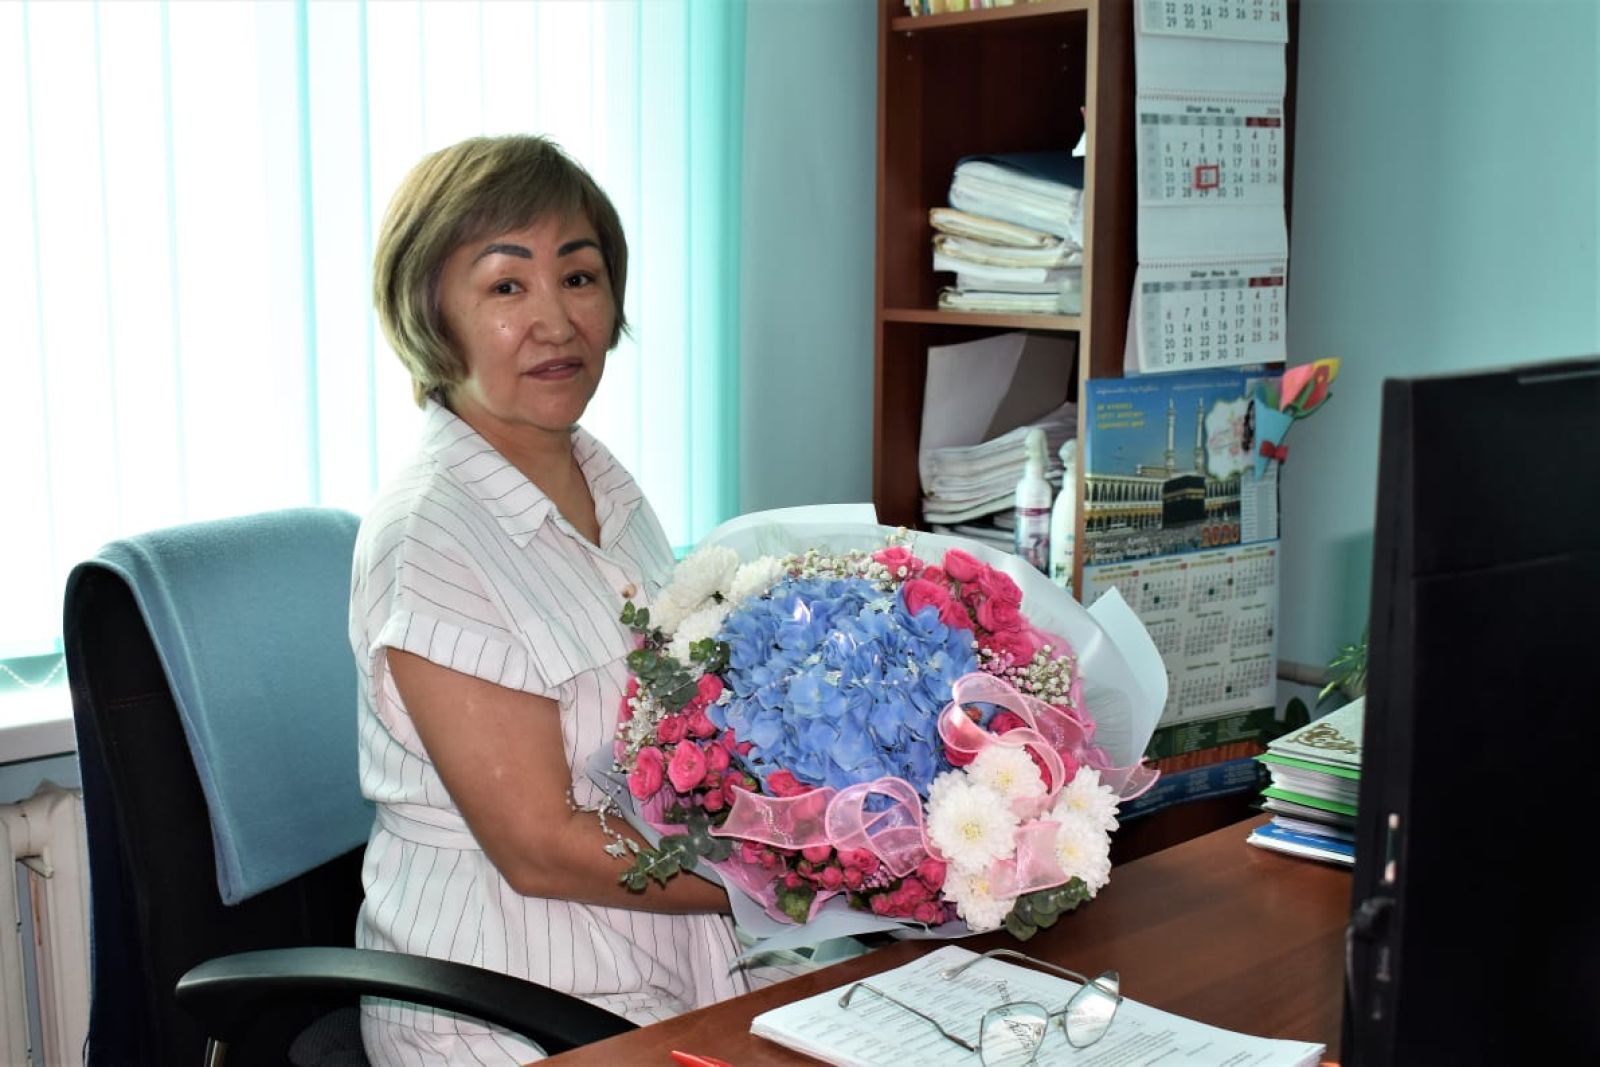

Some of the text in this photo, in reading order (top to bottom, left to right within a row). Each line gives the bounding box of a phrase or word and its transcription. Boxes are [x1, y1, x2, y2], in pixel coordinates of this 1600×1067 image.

[1201, 5, 1211, 16] 24
[1218, 7, 1229, 18] 25
[1253, 10, 1263, 20] 27
[1182, 142, 1187, 151] 7
[1233, 143, 1242, 153] 10
[1181, 158, 1190, 168] 14
[1233, 158, 1241, 168] 17
[1236, 304, 1245, 314] 10
[1270, 302, 1279, 312] 12
[1165, 324, 1174, 334] 13
[1183, 323, 1192, 333] 14
[1200, 321, 1210, 331] 15
[1218, 320, 1227, 330] 16
[1235, 318, 1245, 329] 17
[1200, 336, 1210, 346] 22
[1217, 334, 1227, 344] 23
[1234, 333, 1244, 344] 24
[1251, 331, 1261, 342] 25
[1165, 353, 1175, 364] 27
[1183, 352, 1193, 362] 28
[1200, 350, 1210, 361] 29
